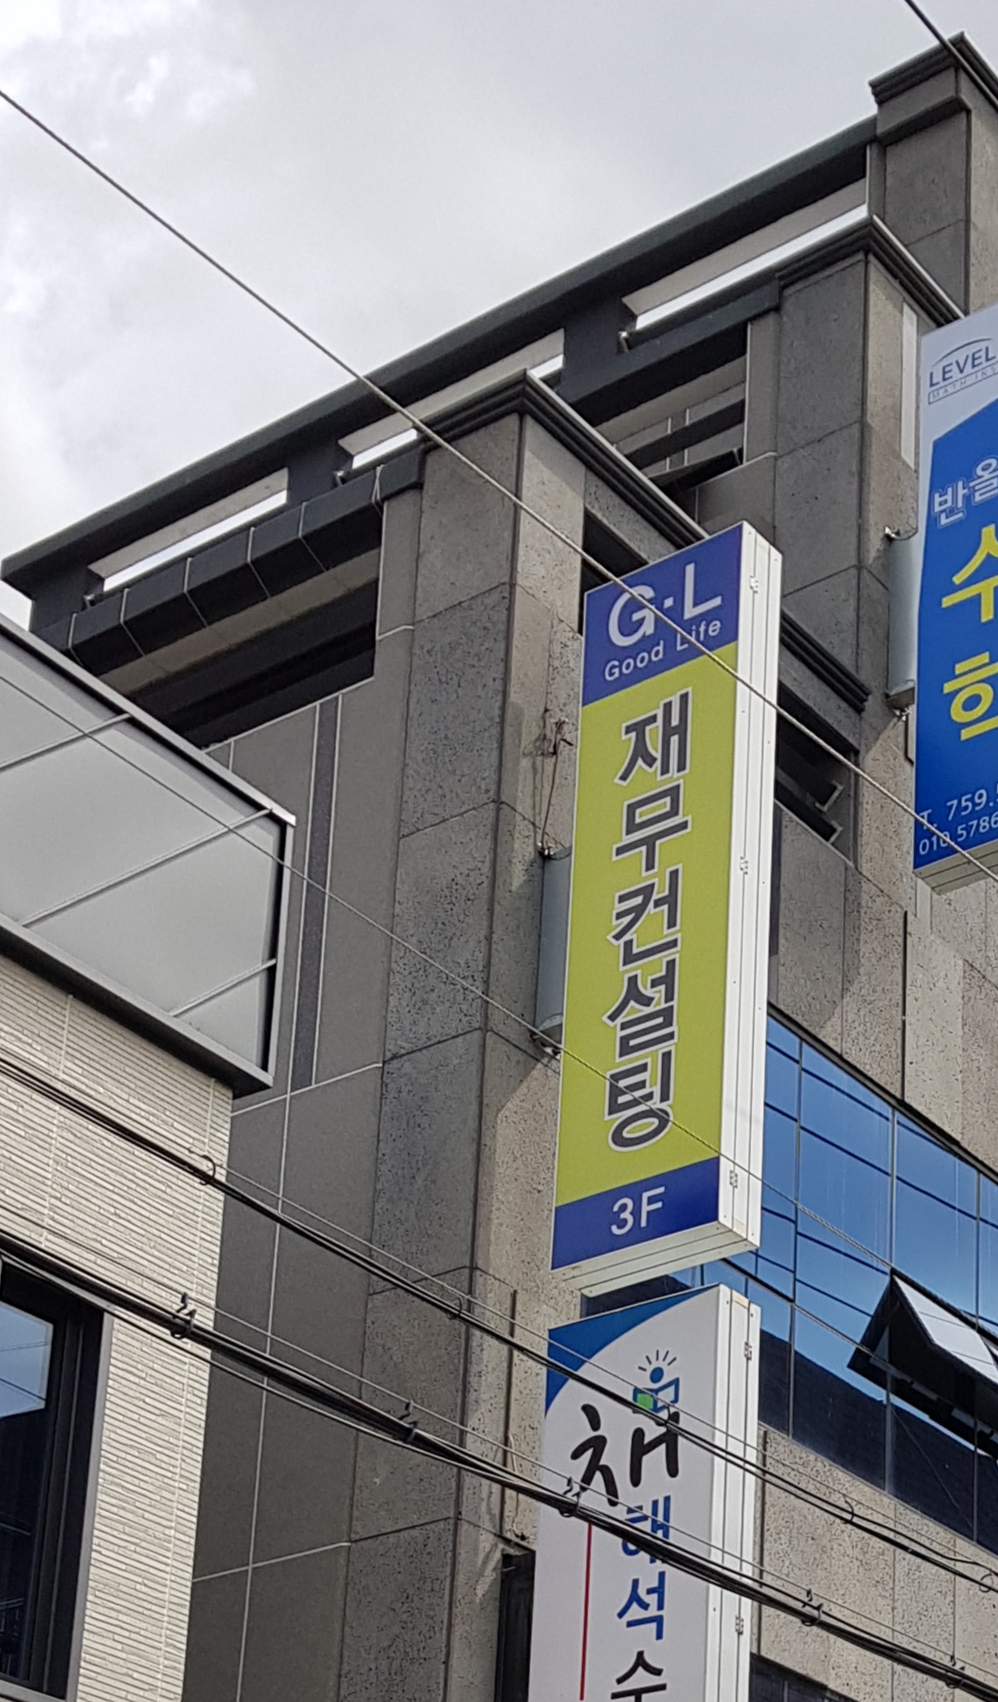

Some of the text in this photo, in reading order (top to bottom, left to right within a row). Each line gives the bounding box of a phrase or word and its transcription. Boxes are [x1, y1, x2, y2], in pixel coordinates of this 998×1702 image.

[929, 346, 996, 388] LEVEL
[932, 380, 967, 399] MATH
[604, 620, 722, 681] Good Life
[610, 1186, 666, 1236] 3F
